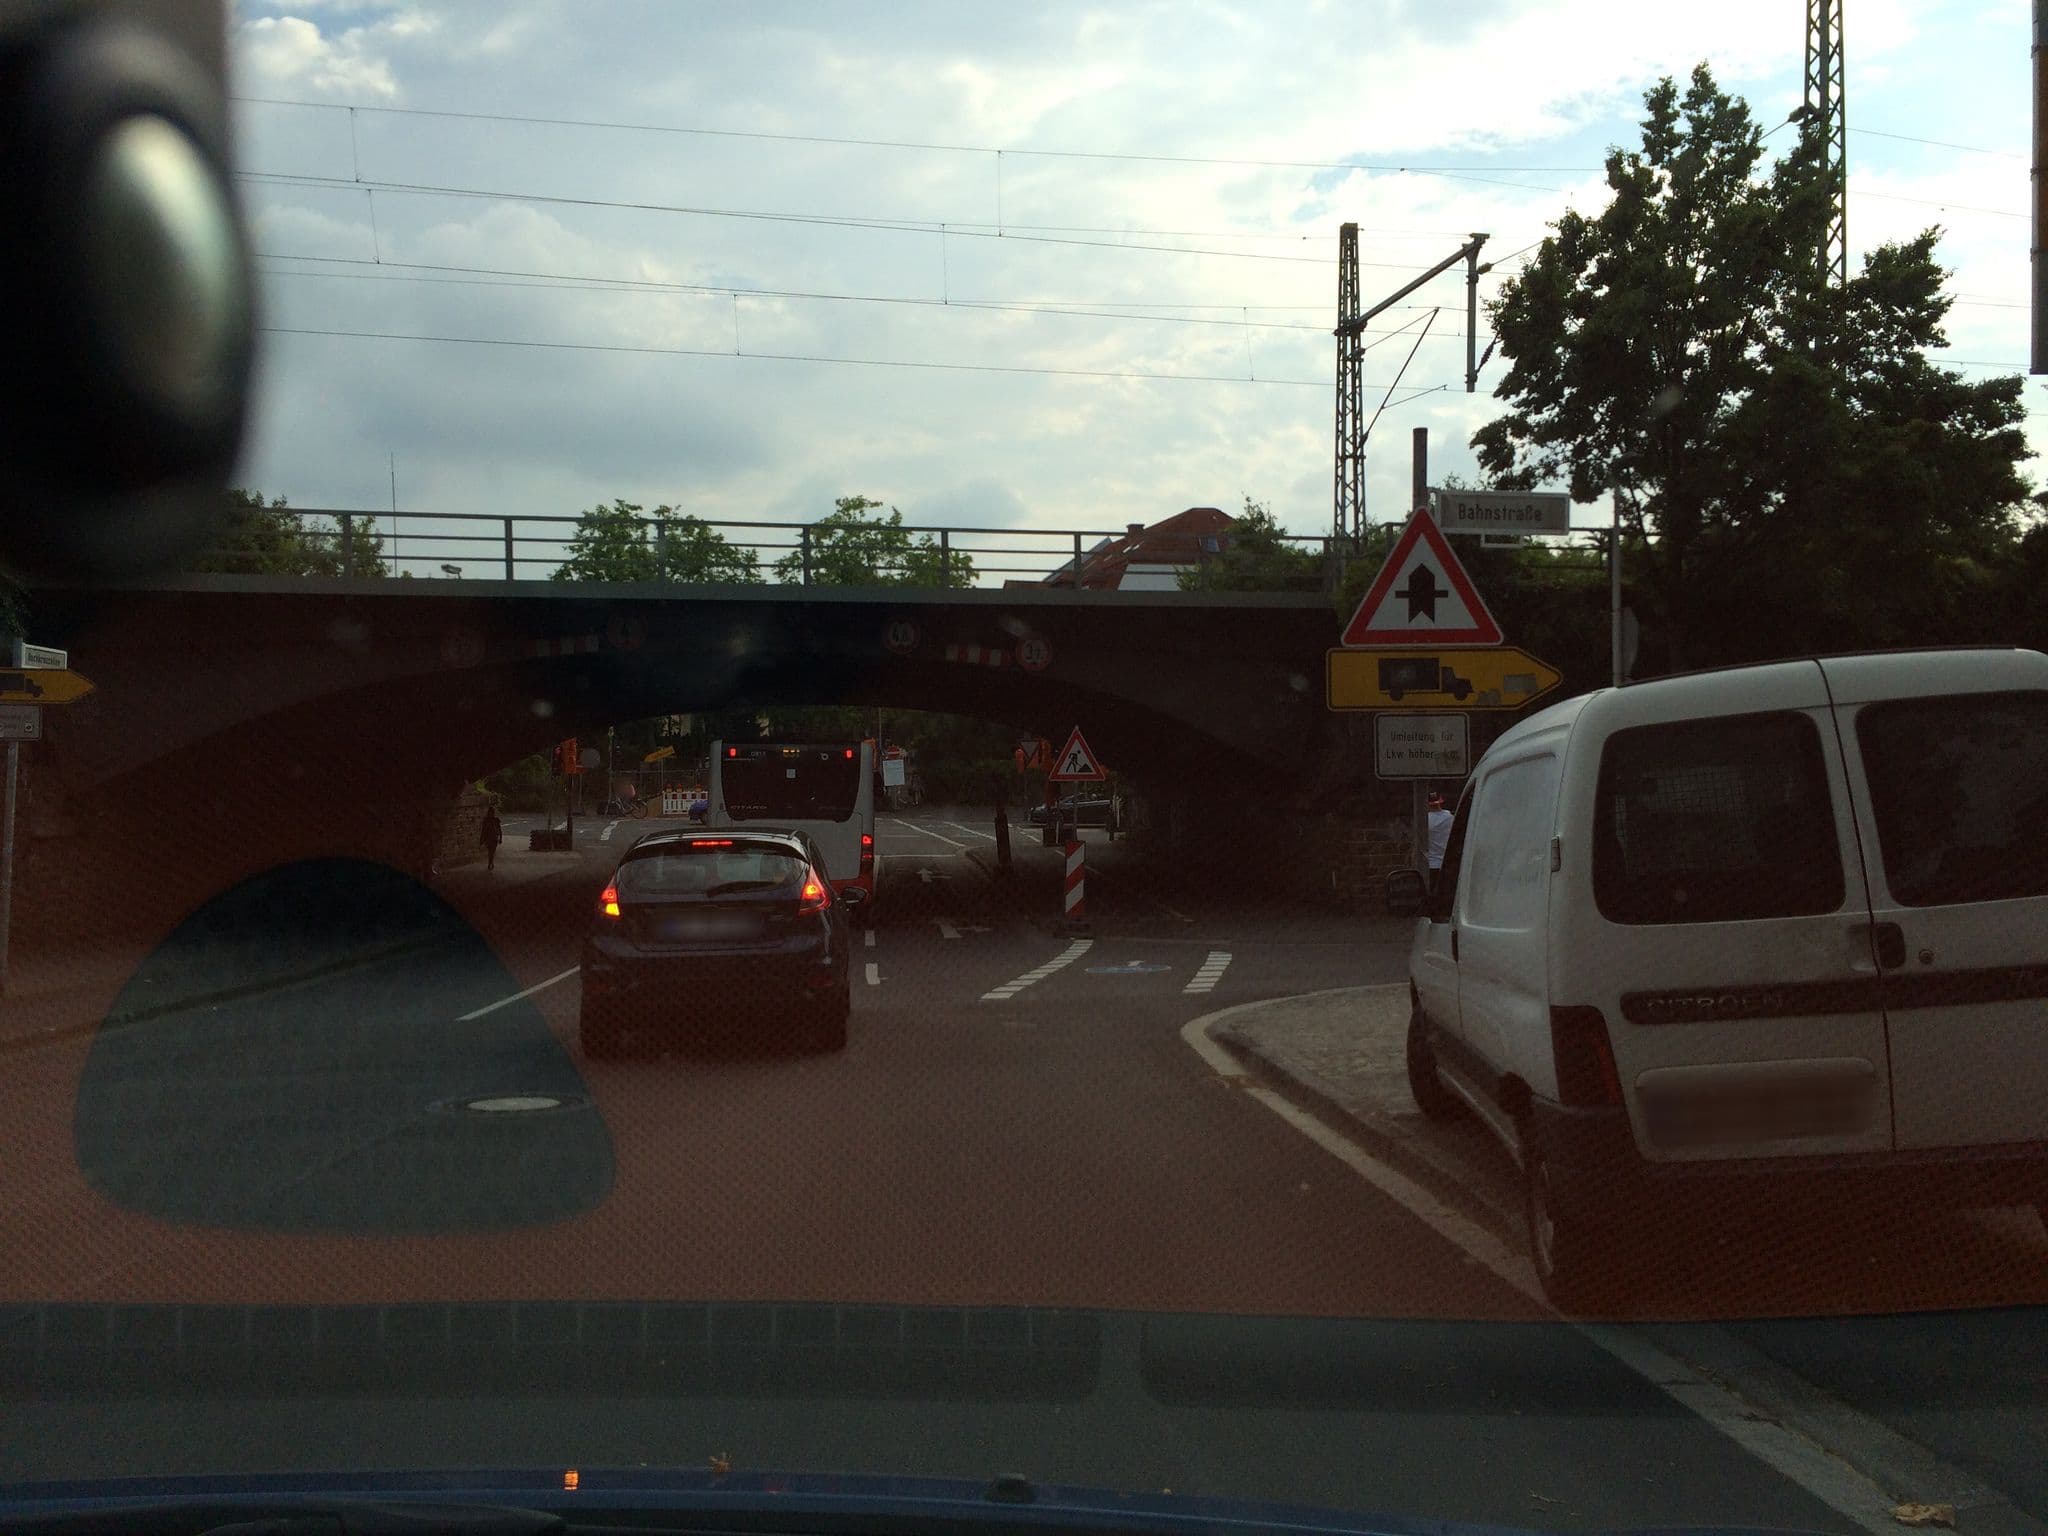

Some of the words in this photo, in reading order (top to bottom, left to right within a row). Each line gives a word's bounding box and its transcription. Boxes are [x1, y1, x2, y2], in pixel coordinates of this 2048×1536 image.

[1457, 503, 1543, 522] Bahnstraße
[1390, 730, 1436, 743] Umleitung
[1440, 730, 1454, 742] für
[1386, 748, 1404, 759] Lkw
[1408, 748, 1435, 760] höher
